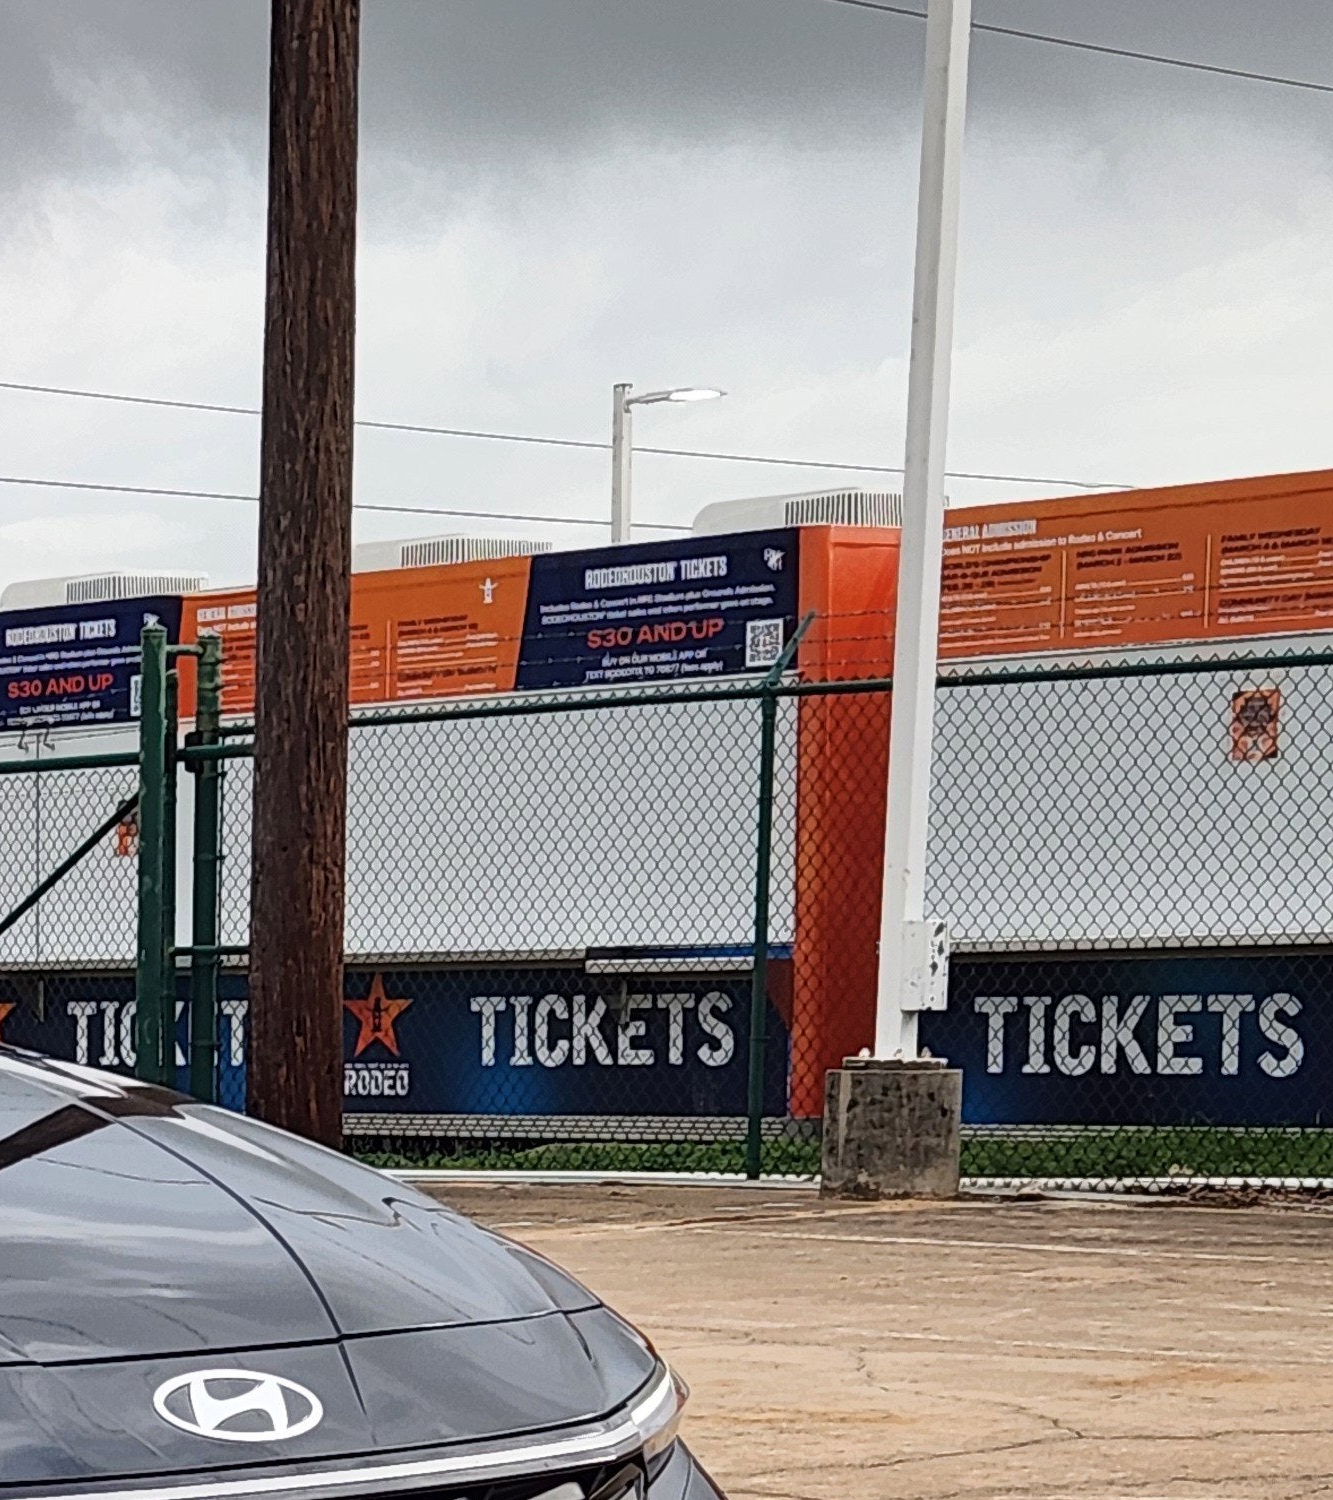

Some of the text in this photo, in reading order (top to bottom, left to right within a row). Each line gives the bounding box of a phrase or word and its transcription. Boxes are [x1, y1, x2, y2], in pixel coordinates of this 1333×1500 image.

[680, 555, 727, 581] TICKETS
[635, 621, 687, 645] AND
[690, 618, 724, 639] UP
[46, 676, 85, 695] AND
[88, 673, 114, 691] UP
[470, 992, 734, 1068] TICKETS
[974, 993, 1305, 1077] TICKETS
[343, 1069, 410, 1096] RODEO
